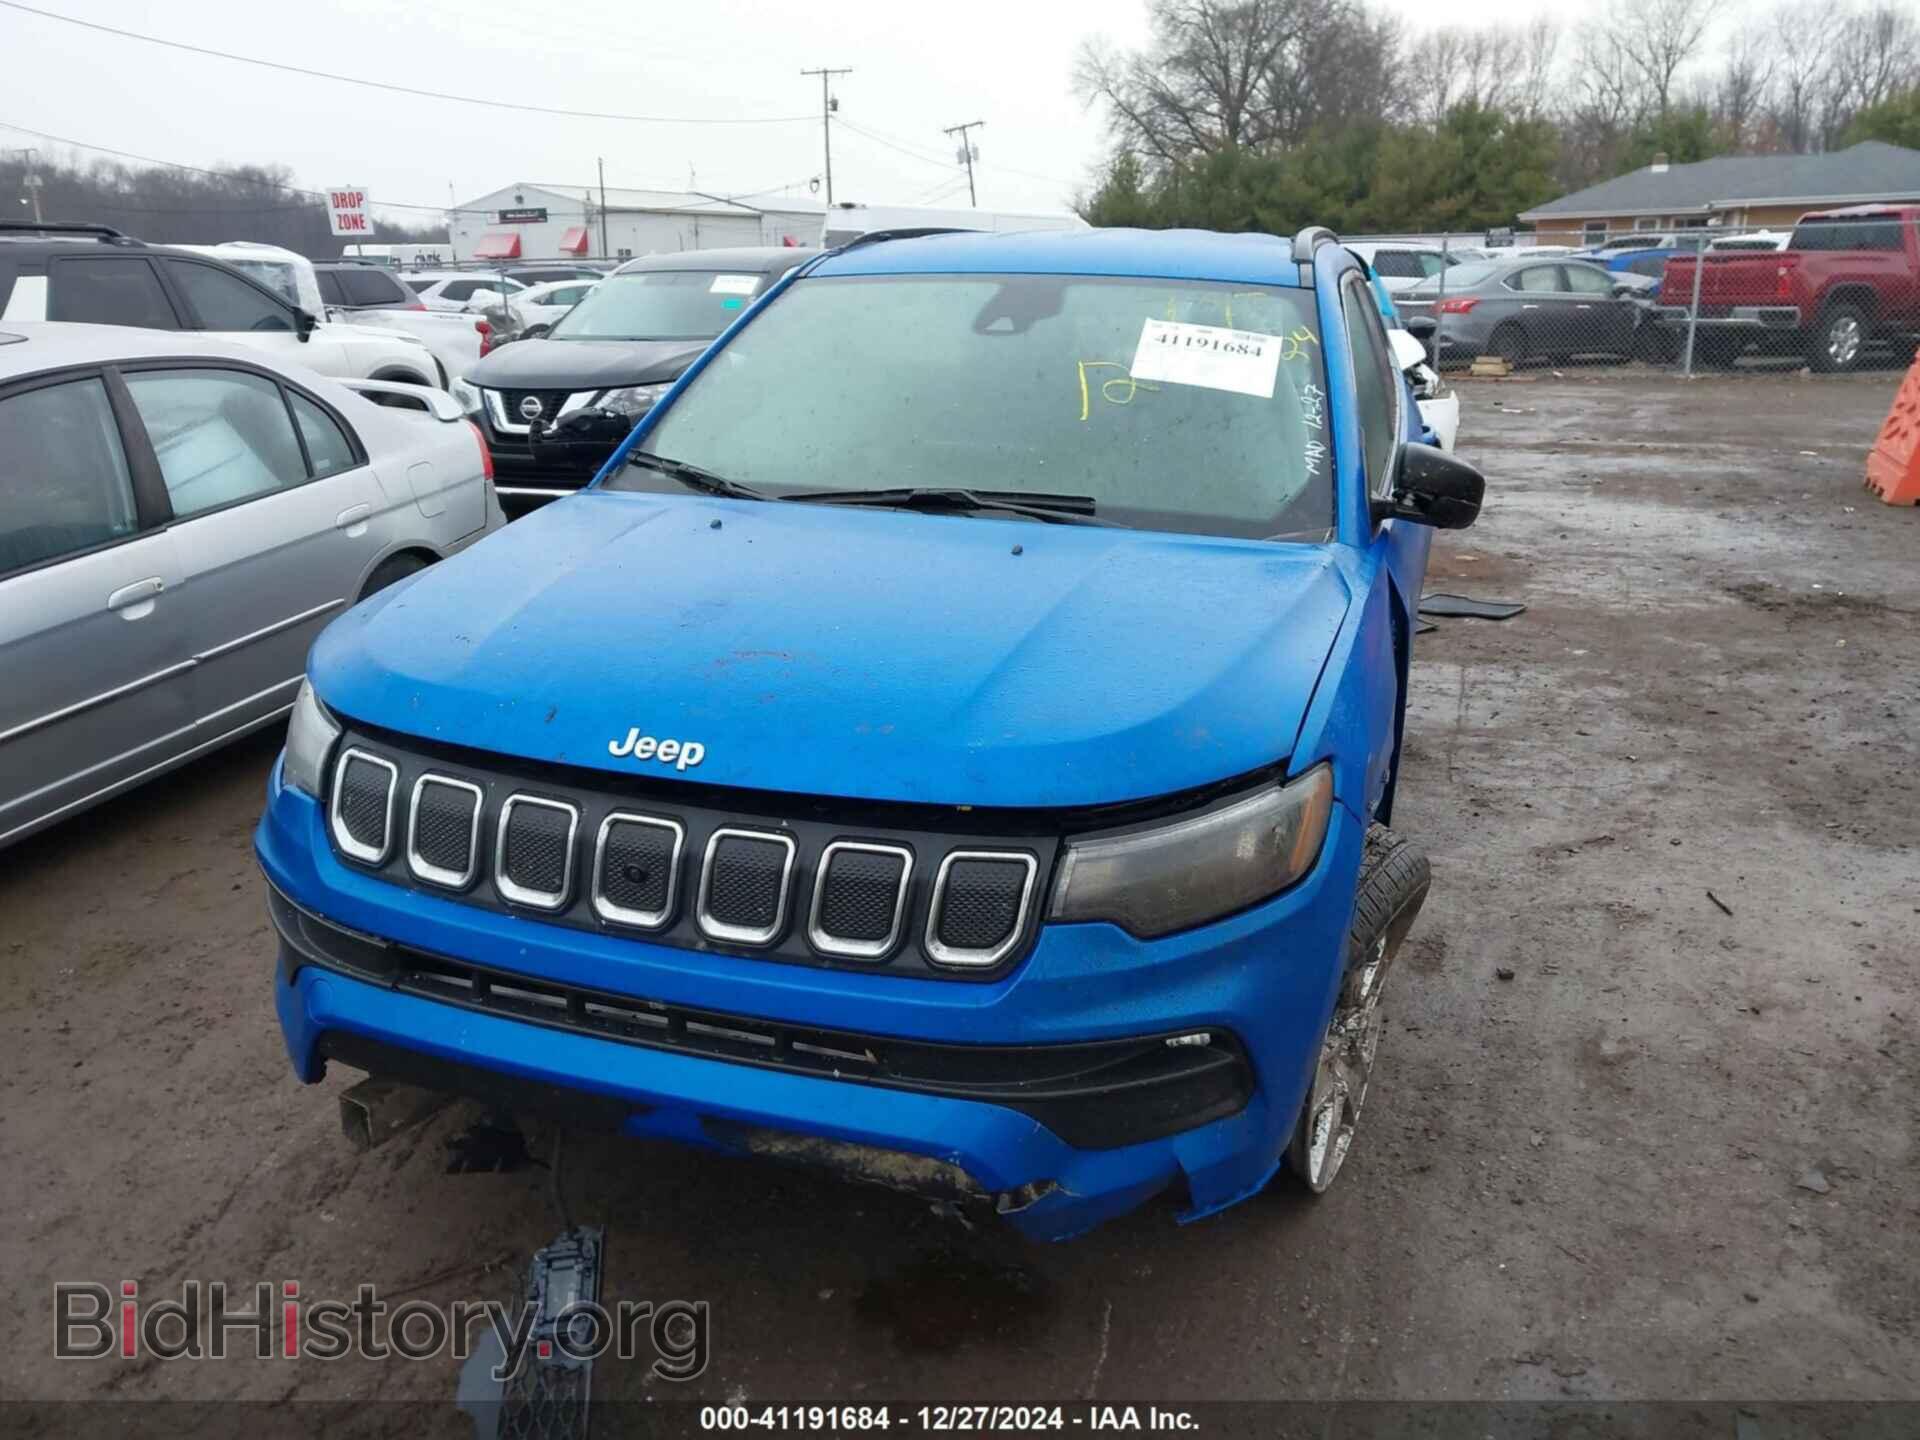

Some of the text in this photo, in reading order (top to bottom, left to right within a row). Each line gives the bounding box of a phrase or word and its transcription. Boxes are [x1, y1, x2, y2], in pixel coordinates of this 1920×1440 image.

[331, 191, 364, 209] DROP
[336, 213, 366, 230] ZONE
[1154, 332, 1263, 358] 41191684
[608, 727, 705, 771] Jeep
